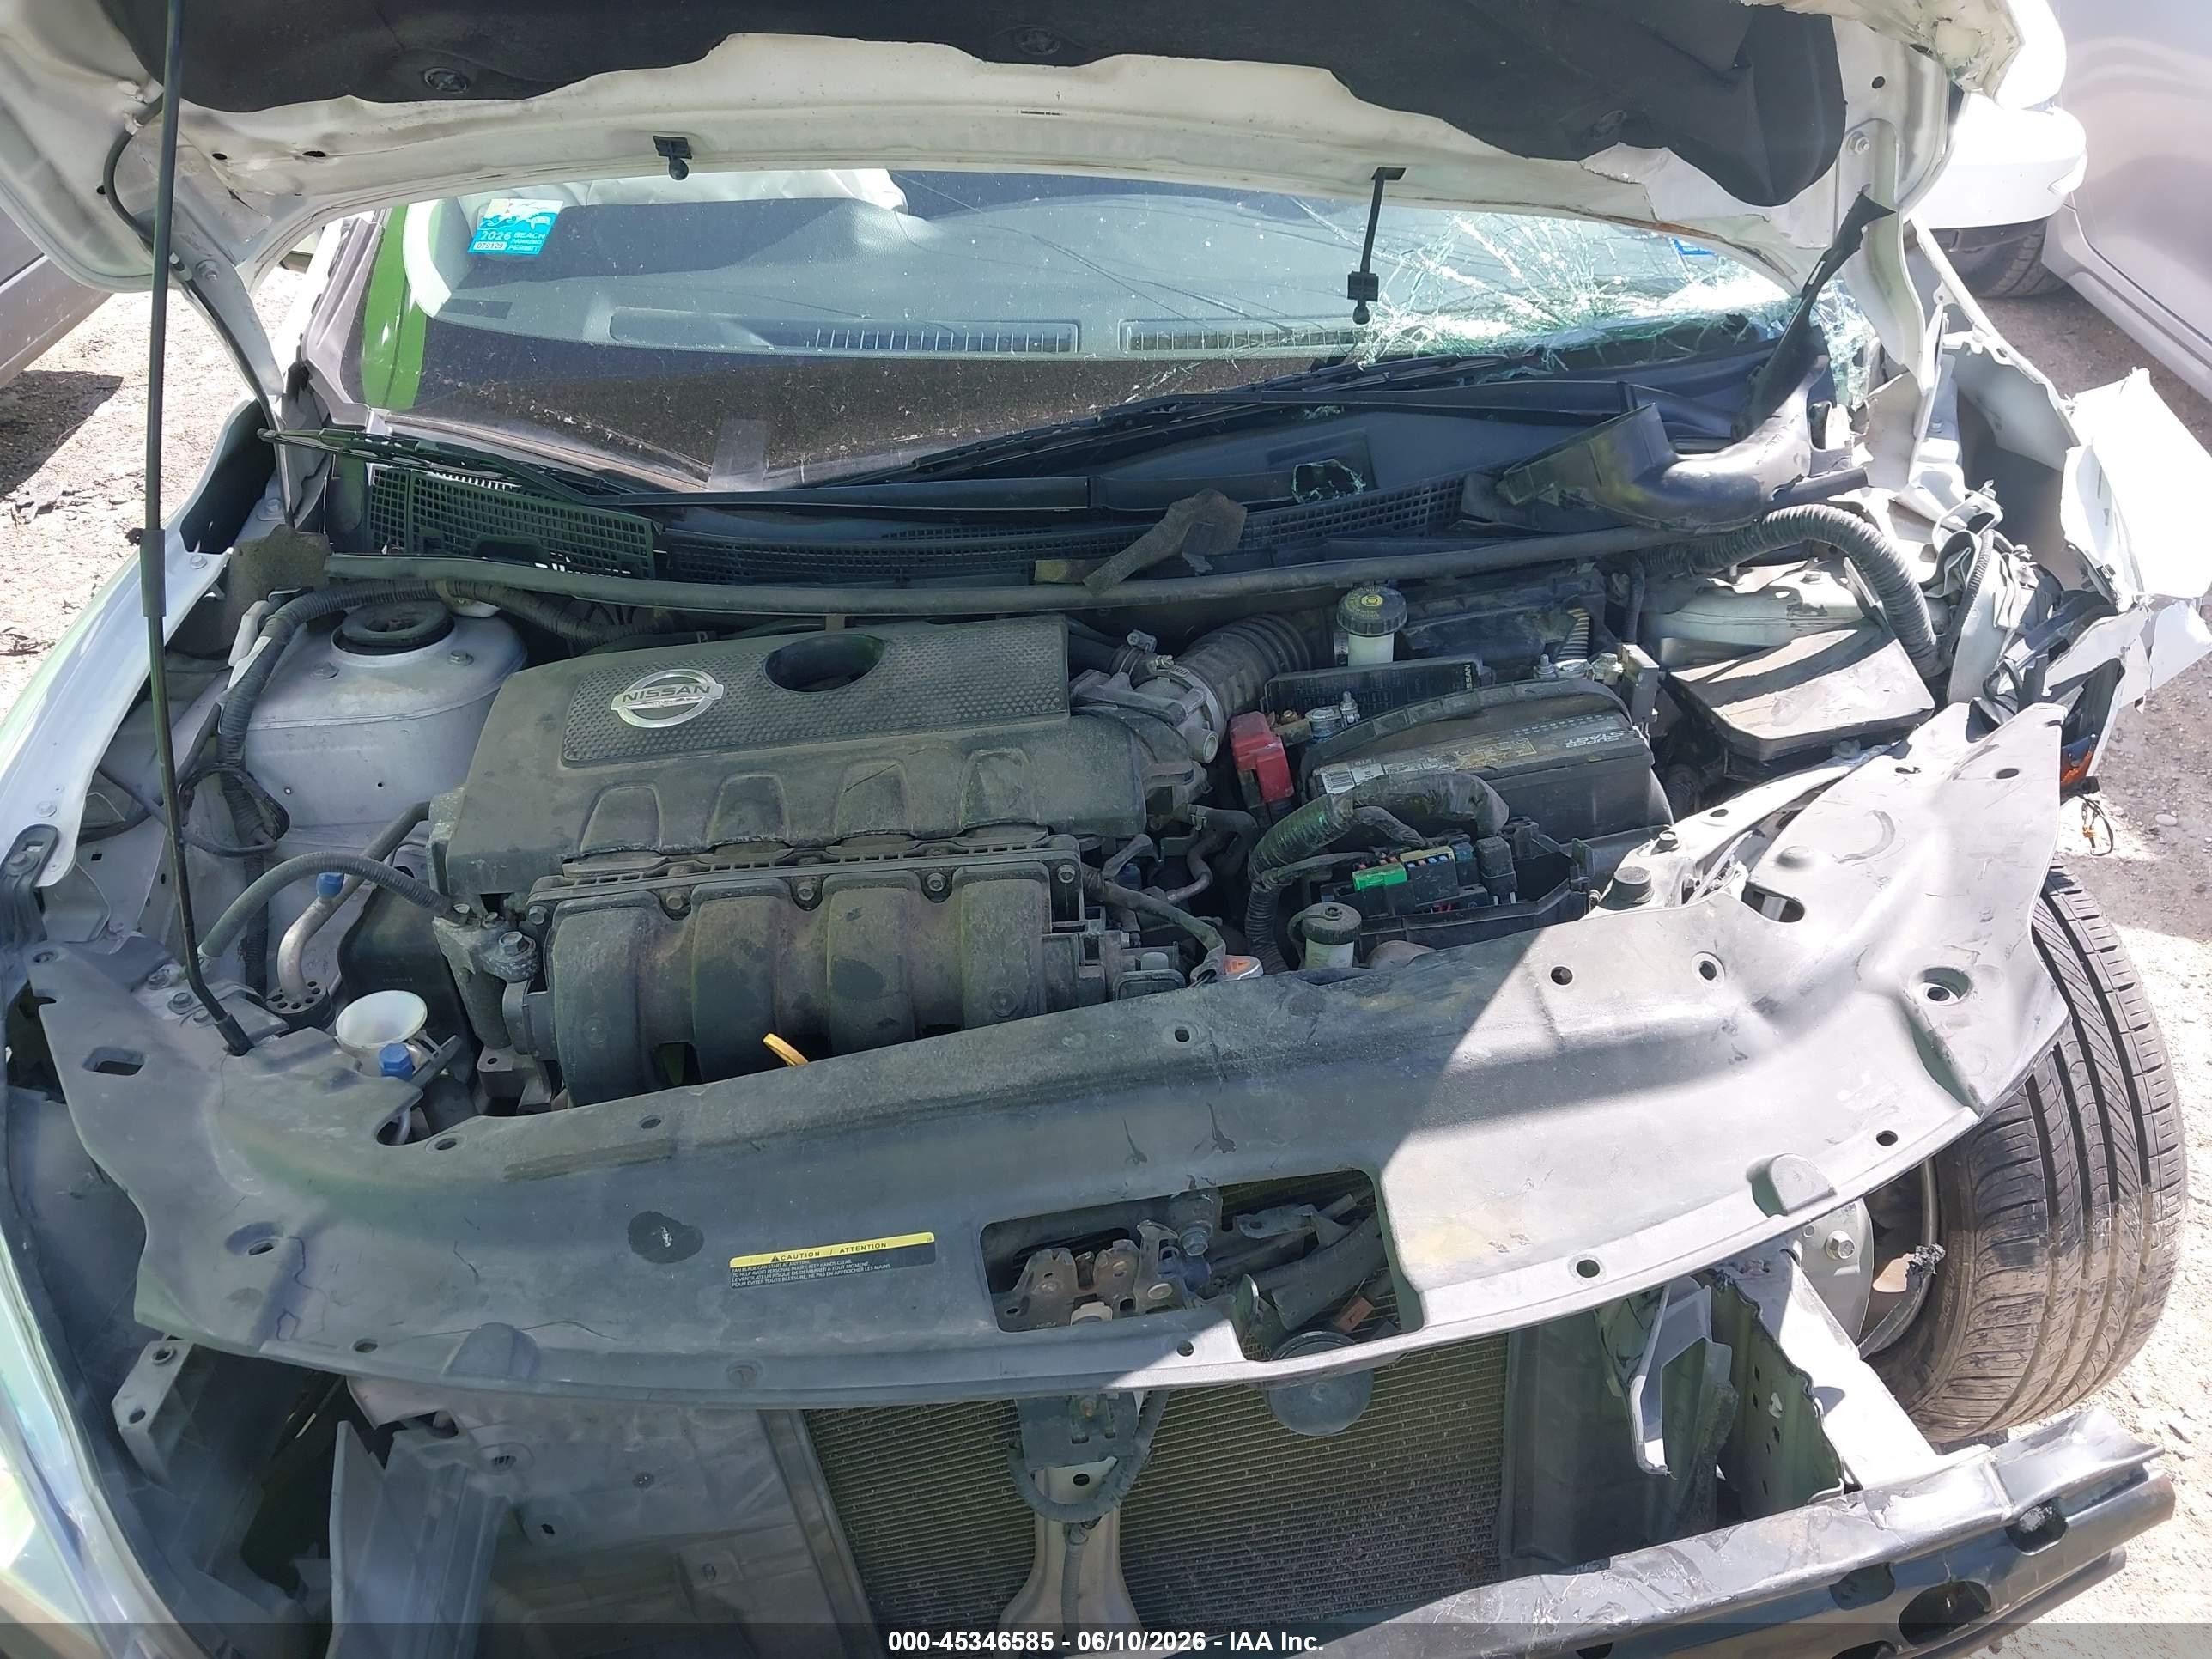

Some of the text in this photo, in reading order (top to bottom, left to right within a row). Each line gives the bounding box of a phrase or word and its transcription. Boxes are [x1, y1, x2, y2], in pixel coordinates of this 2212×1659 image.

[481, 230, 512, 240] 2026
[622, 685, 711, 703] NISSAN
[781, 1251, 820, 1261] CAUTION
[839, 1243, 887, 1254] ATTENTION
